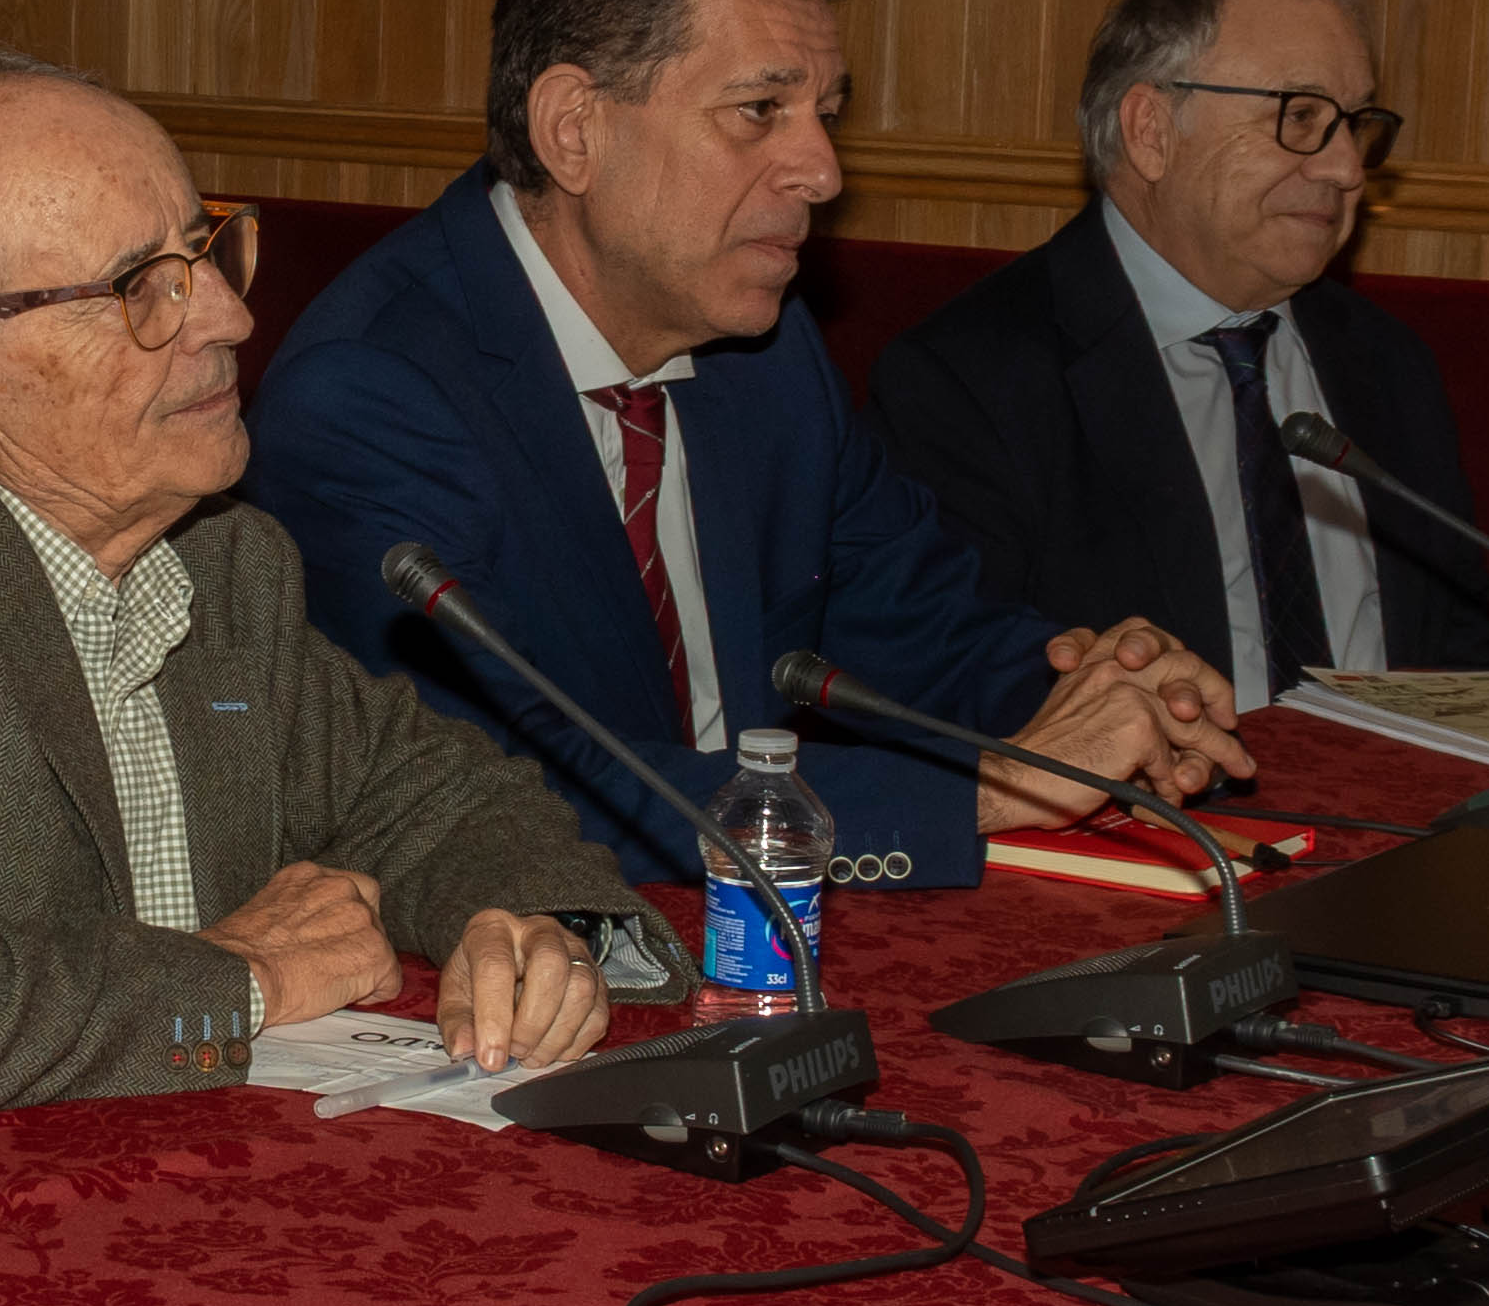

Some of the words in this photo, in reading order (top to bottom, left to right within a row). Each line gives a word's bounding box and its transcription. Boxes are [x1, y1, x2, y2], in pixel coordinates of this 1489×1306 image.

[765, 972, 788, 985] 33cl
[1207, 949, 1285, 1014] PHILIPS
[767, 1031, 861, 1101] PHILIPS
